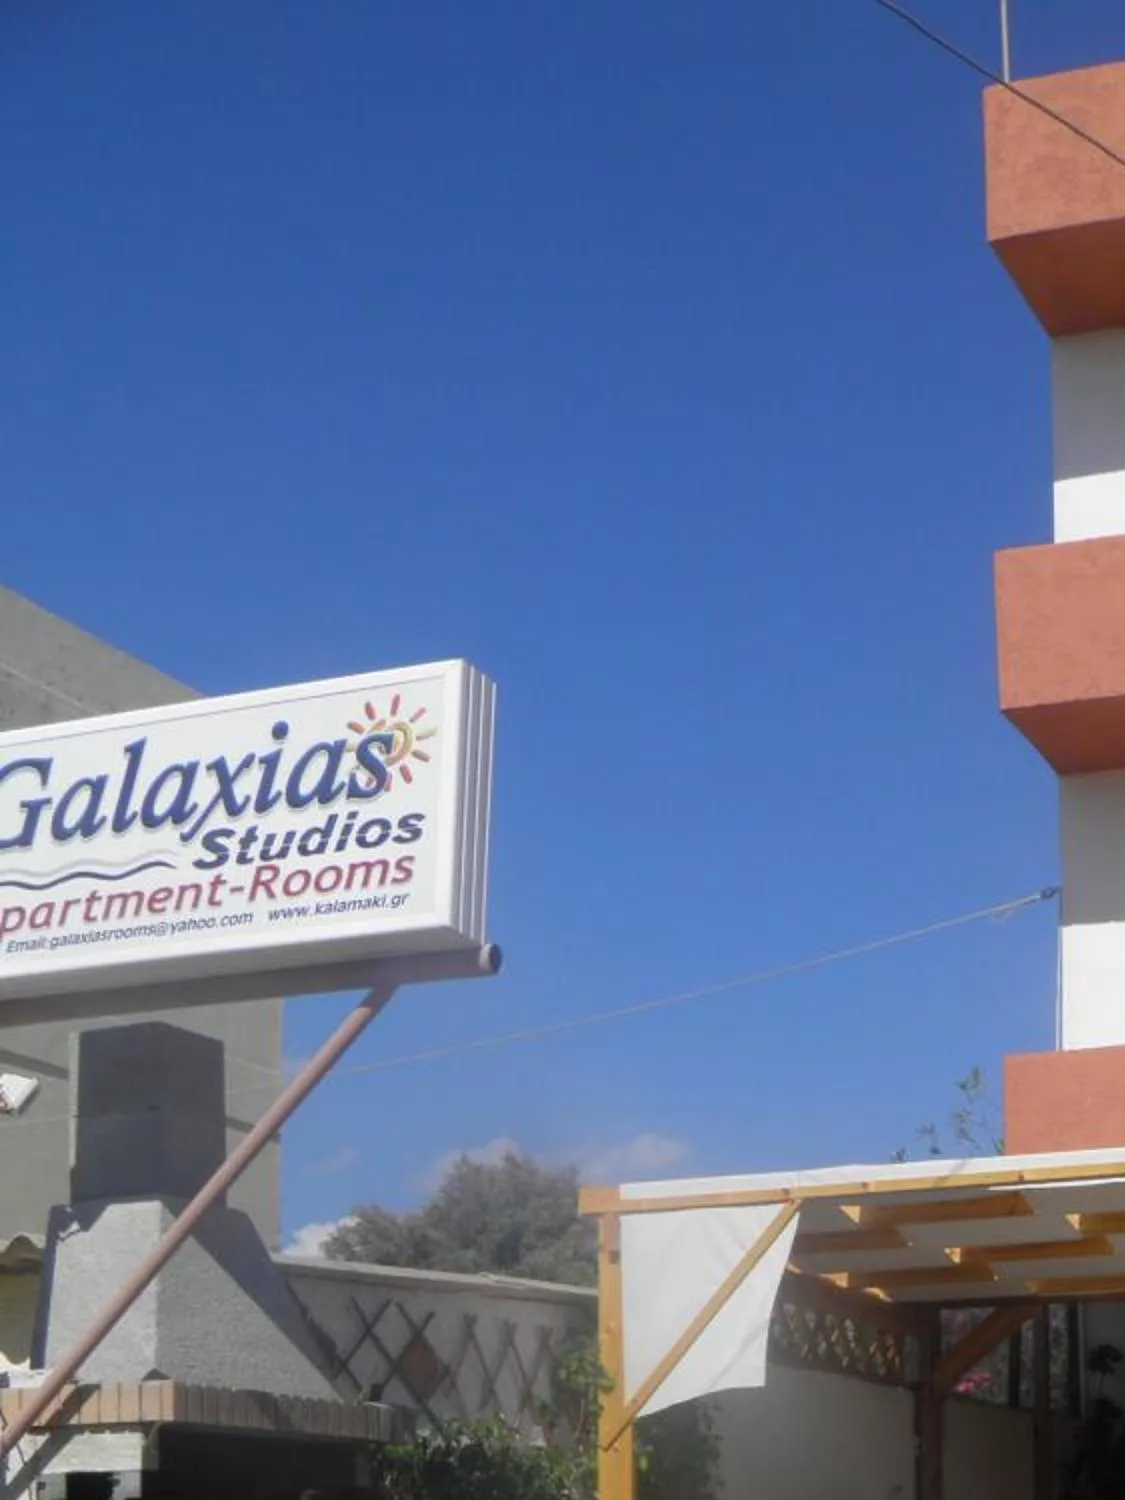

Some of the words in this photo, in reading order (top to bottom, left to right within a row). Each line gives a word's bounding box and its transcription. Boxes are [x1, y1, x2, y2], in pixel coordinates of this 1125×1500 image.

[0, 720, 395, 850] Galaxias
[192, 811, 426, 869] Studios
[268, 892, 410, 922] www.kalamaki.gr
